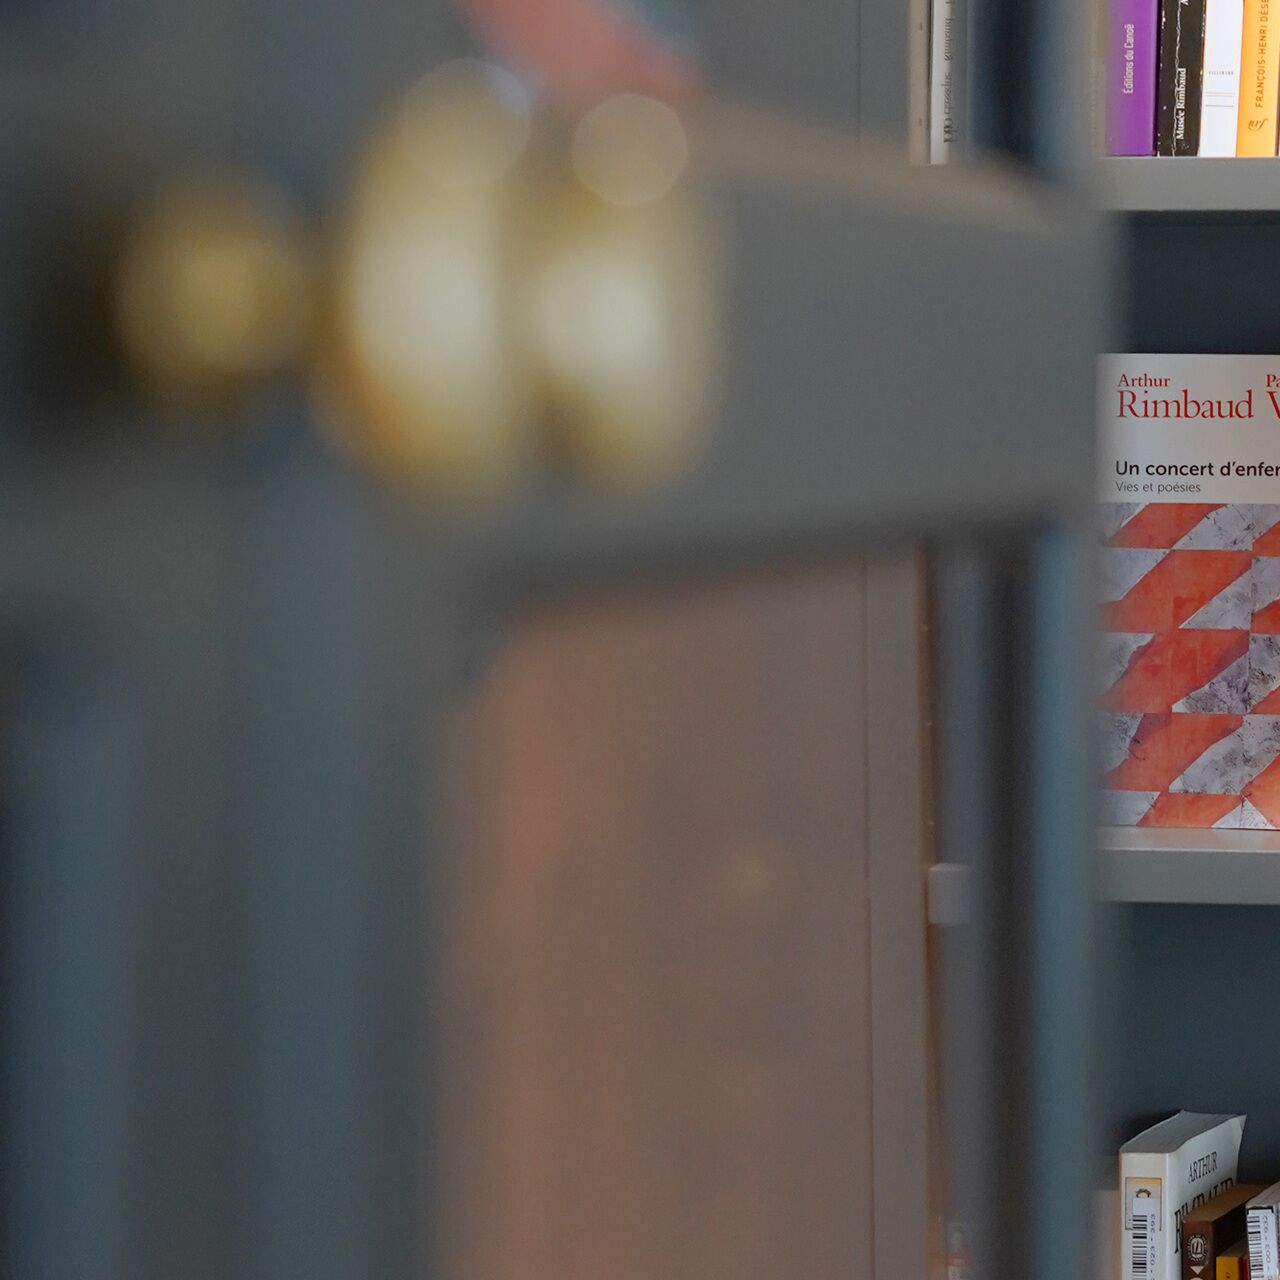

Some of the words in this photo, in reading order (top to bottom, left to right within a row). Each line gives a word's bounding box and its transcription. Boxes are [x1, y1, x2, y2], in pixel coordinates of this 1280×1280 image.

[1256, 23, 1269, 108] FRANÇOIS-HENRI
[1178, 68, 1187, 107] Rimbaud
[1117, 374, 1171, 388] Arthur
[1117, 390, 1255, 420] Rimbaud
[1116, 461, 1140, 476] Un
[1146, 461, 1215, 476] concert
[1116, 481, 1139, 492] Vies
[1142, 482, 1154, 492] et
[1157, 481, 1201, 494] poésies
